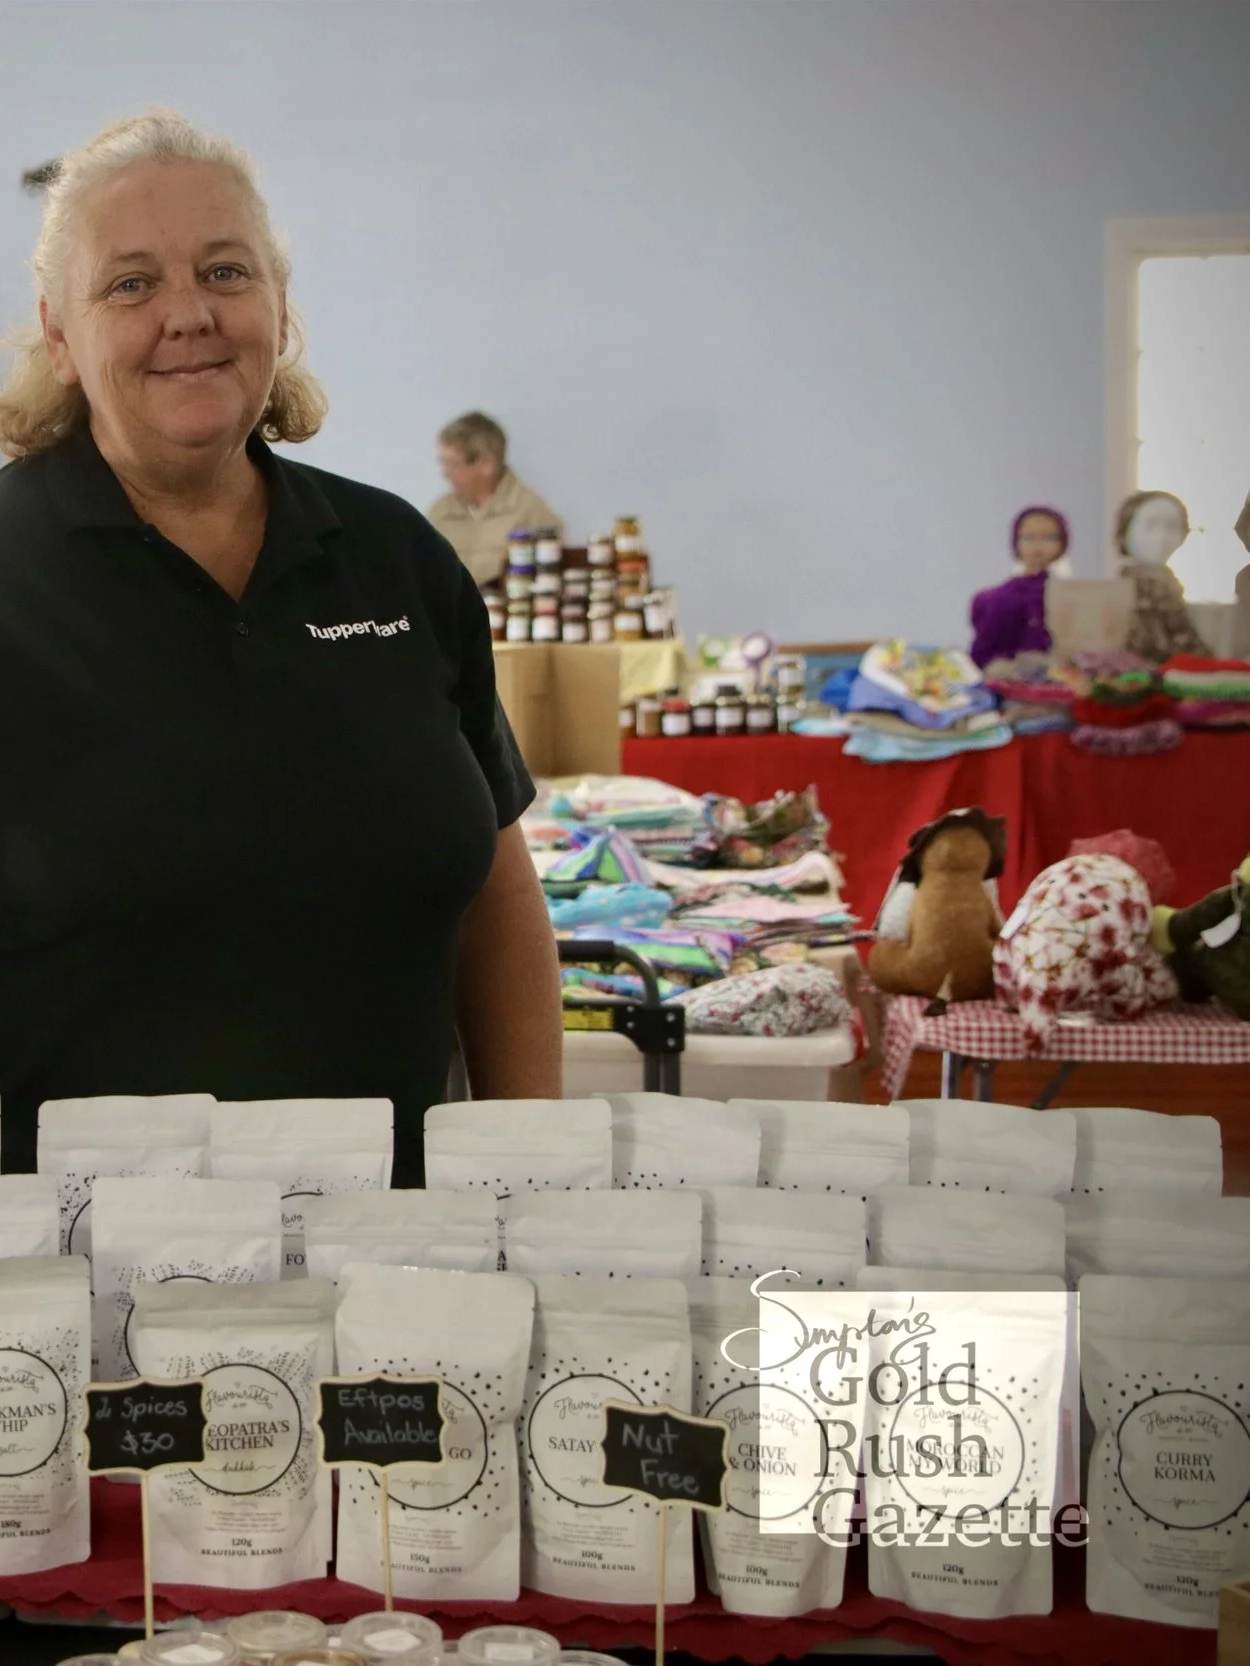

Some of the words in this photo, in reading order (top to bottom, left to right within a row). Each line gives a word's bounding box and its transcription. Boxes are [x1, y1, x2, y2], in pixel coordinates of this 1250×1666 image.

[121, 1396, 188, 1423] Spices
[338, 1387, 425, 1415] Eftpos
[208, 1420, 290, 1437] EOPATRA'S
[344, 1417, 437, 1446] Available
[120, 1429, 175, 1456] $30
[206, 1434, 274, 1451] KITCHEN
[548, 1436, 596, 1453] SATAY
[622, 1420, 679, 1455] Nut
[738, 1443, 787, 1461] CHIVE
[1156, 1451, 1213, 1467] CURRY
[729, 1457, 740, 1470] &
[744, 1458, 797, 1476] ONION
[1154, 1466, 1217, 1482] KORMA
[640, 1459, 700, 1495] Free
[19, 1527, 52, 1537] BLENDS
[231, 1538, 253, 1548] 120g
[201, 1548, 249, 1557] BEAUTIFUL
[250, 1547, 283, 1556] BLENDS
[553, 1557, 599, 1570] BEAUTIFUL
[601, 1563, 636, 1572] BLENDS
[765, 1579, 801, 1588] BLENDS
[961, 1577, 999, 1587] BLENDS
